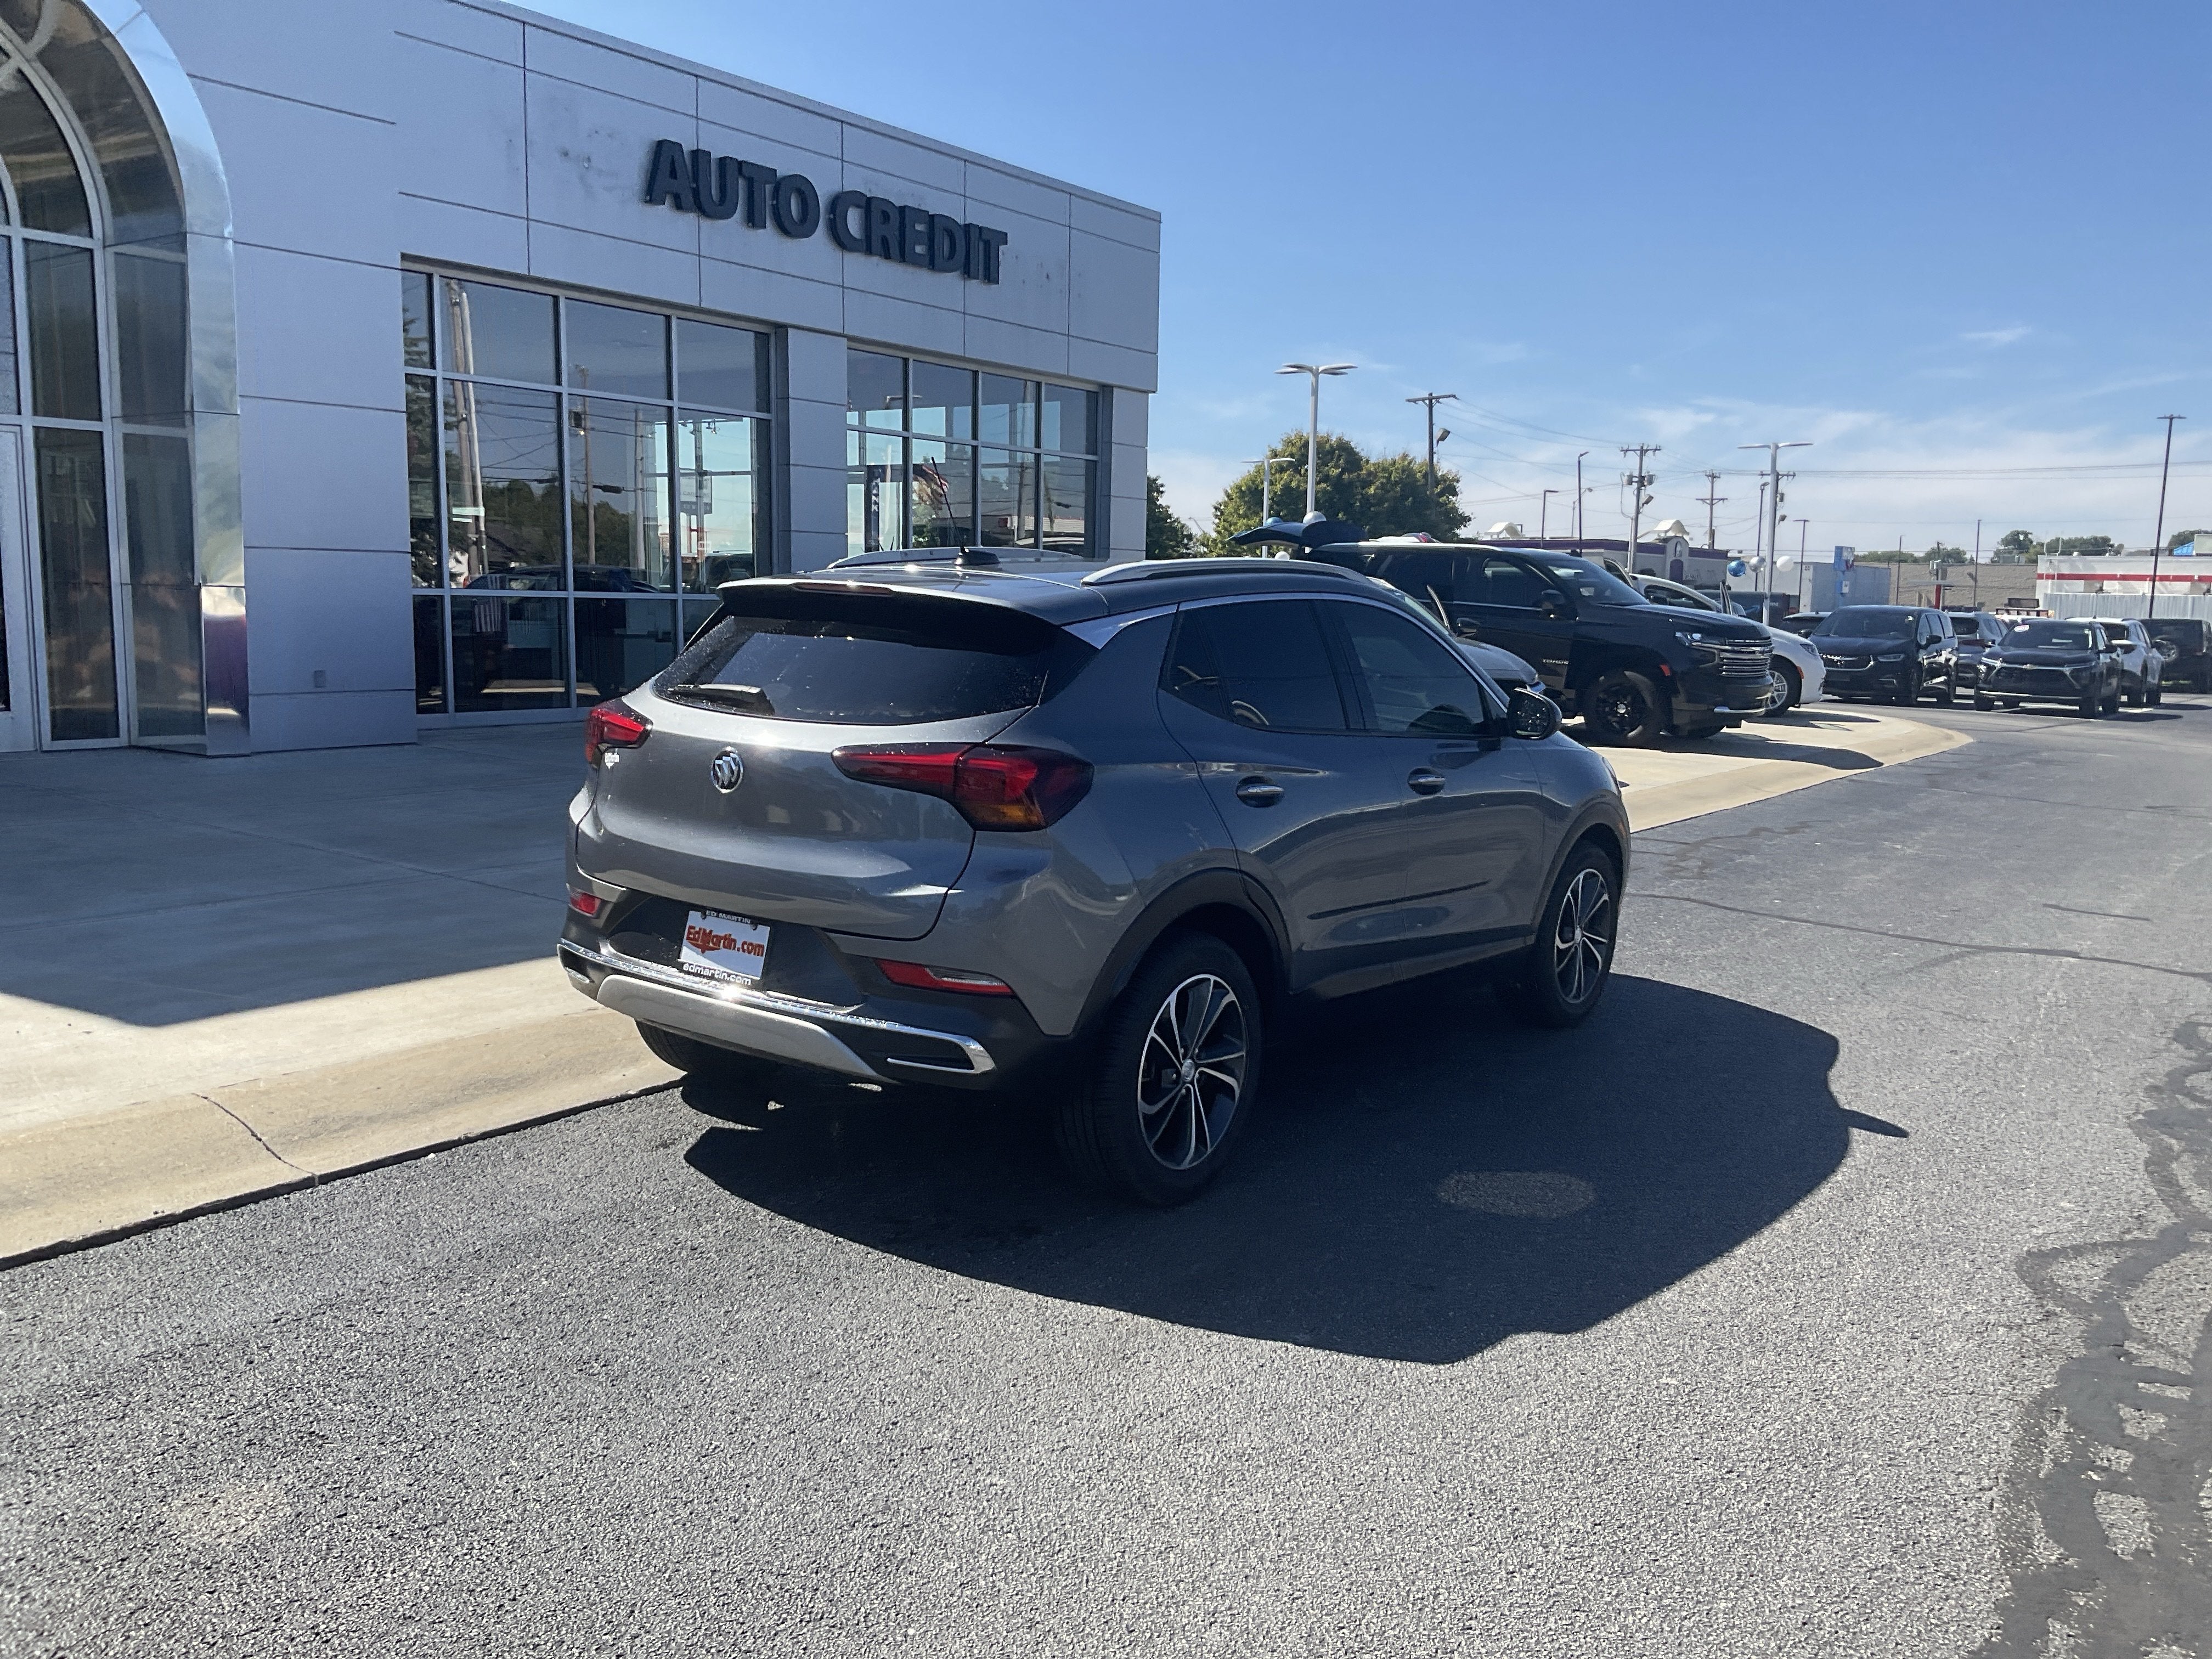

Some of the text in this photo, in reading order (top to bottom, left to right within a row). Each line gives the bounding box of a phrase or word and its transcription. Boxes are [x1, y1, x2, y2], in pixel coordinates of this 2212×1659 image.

[644, 139, 1008, 285] AUTO CREDIT
[719, 912, 751, 924] MARTIN
[683, 962, 752, 986] edmartin.com
